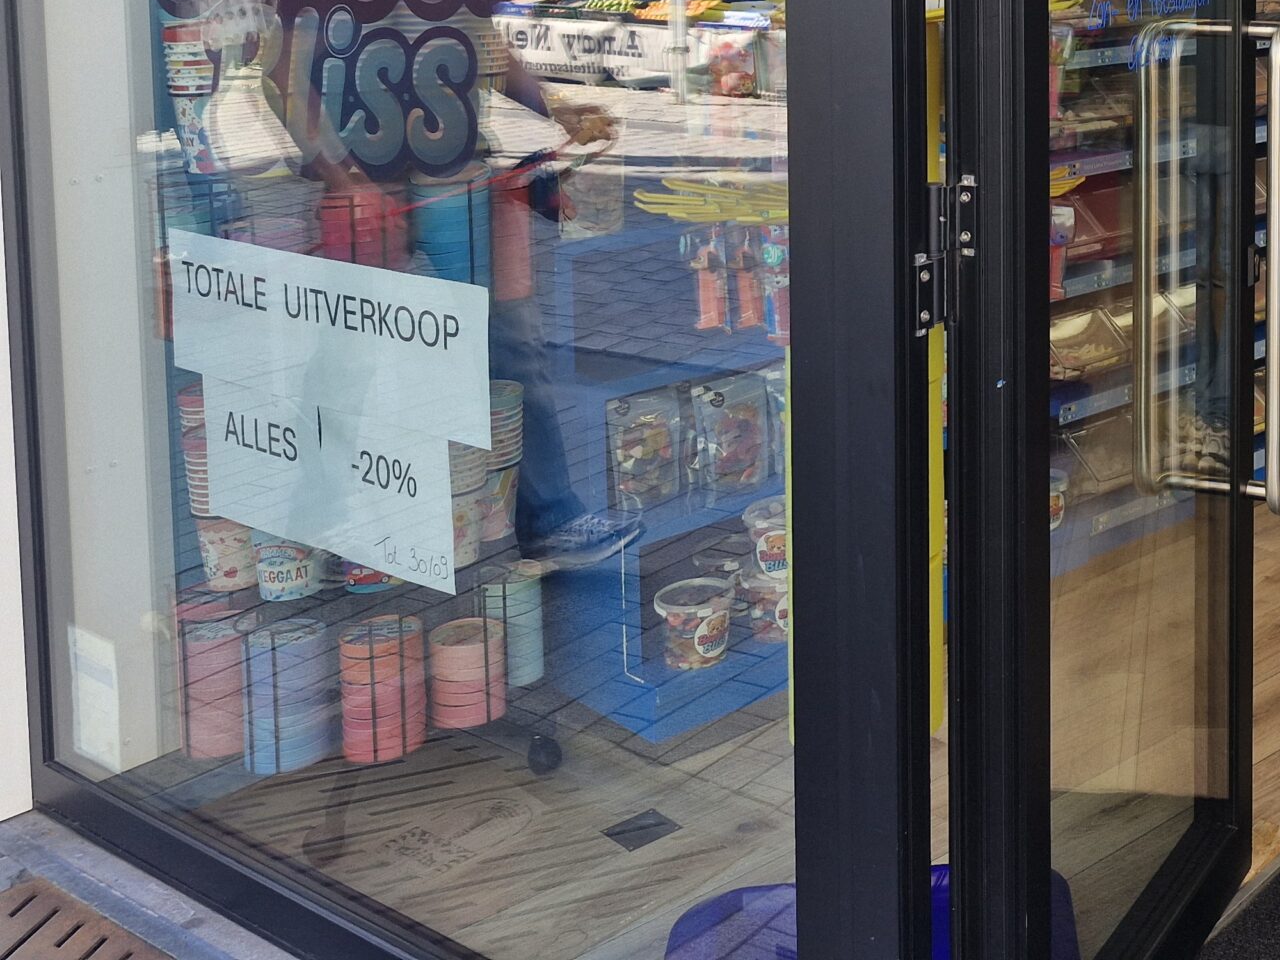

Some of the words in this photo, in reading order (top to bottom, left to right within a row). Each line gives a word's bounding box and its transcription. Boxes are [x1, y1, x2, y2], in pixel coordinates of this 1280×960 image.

[181, 260, 268, 313] TOTALE
[283, 282, 460, 351] UITVERKOOP
[224, 411, 298, 462] ALLES
[351, 449, 417, 499] -20%
[408, 547, 449, 581] 30/09
